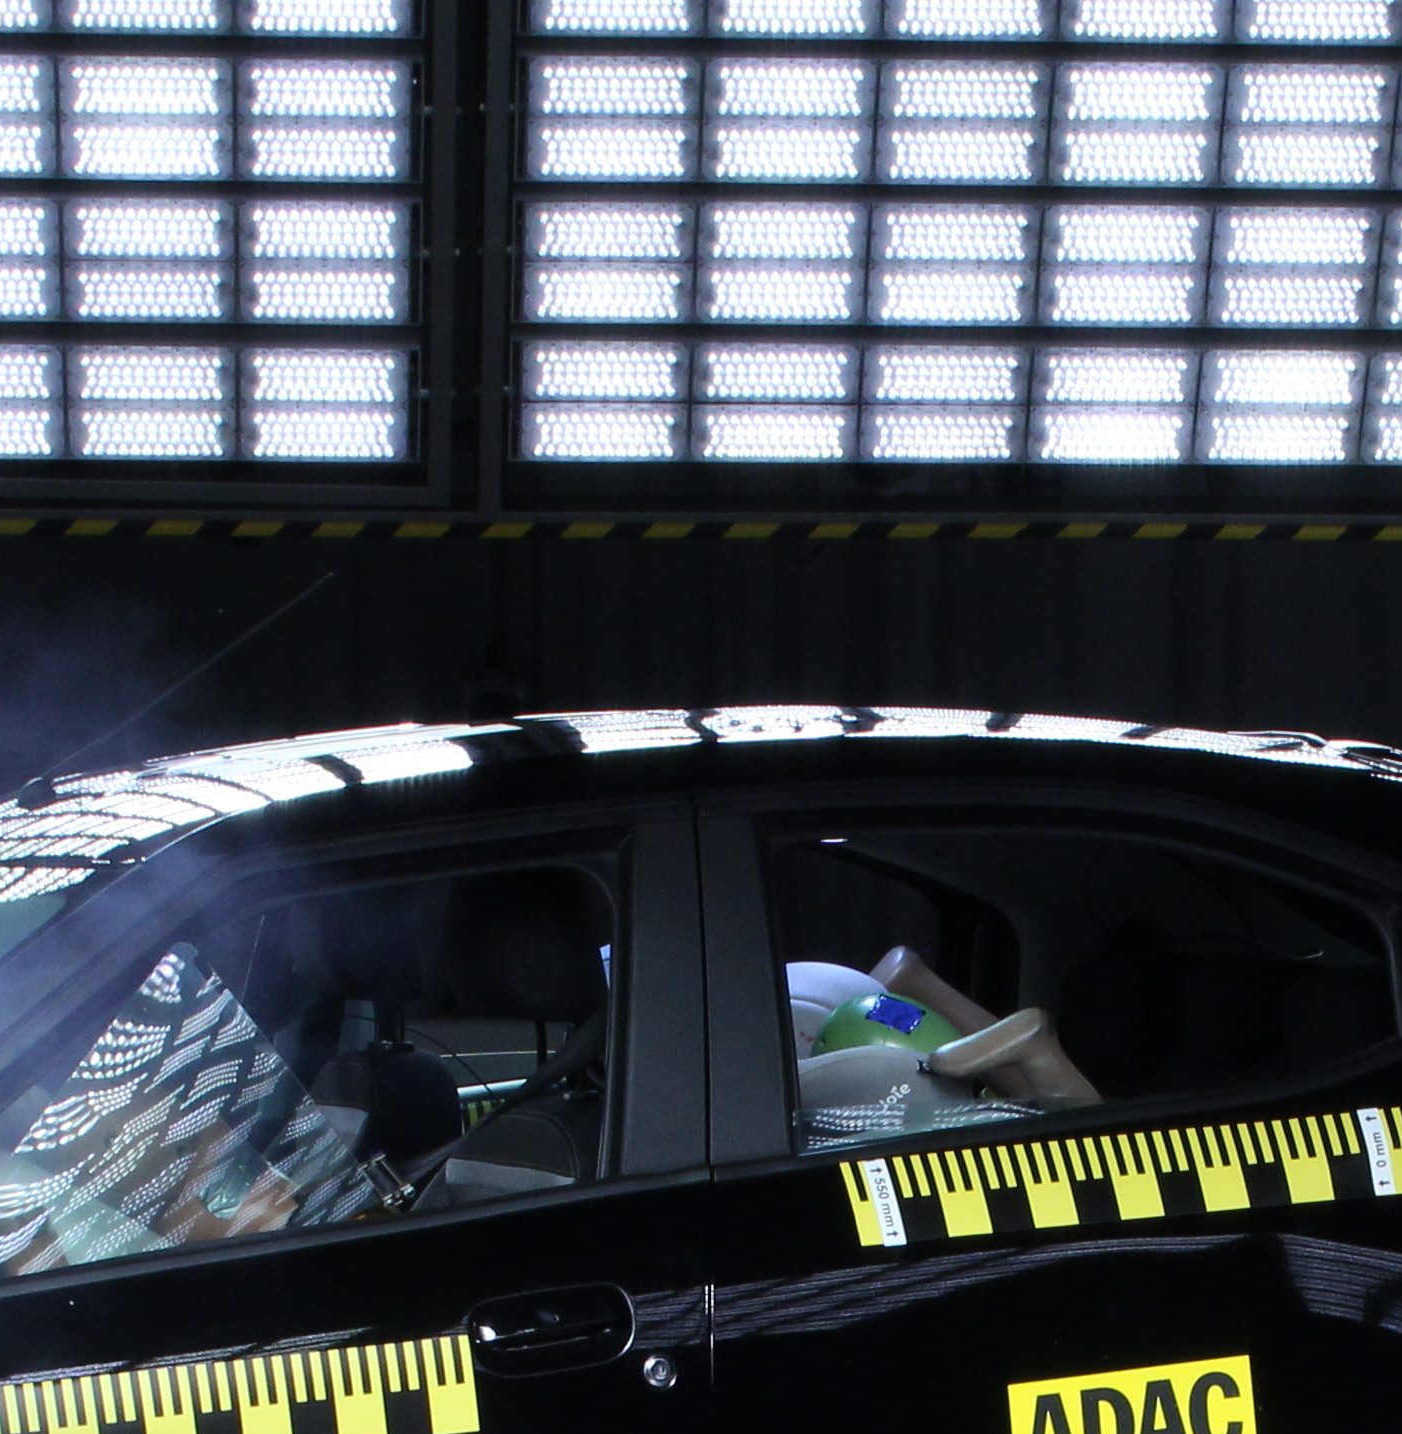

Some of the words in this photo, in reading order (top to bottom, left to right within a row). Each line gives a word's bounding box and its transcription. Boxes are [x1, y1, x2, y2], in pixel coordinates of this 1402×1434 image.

[1372, 1132, 1385, 1156] mm
[1375, 1160, 1387, 1168] 0
[874, 1177, 890, 1200] 550
[881, 1203, 895, 1228] mm
